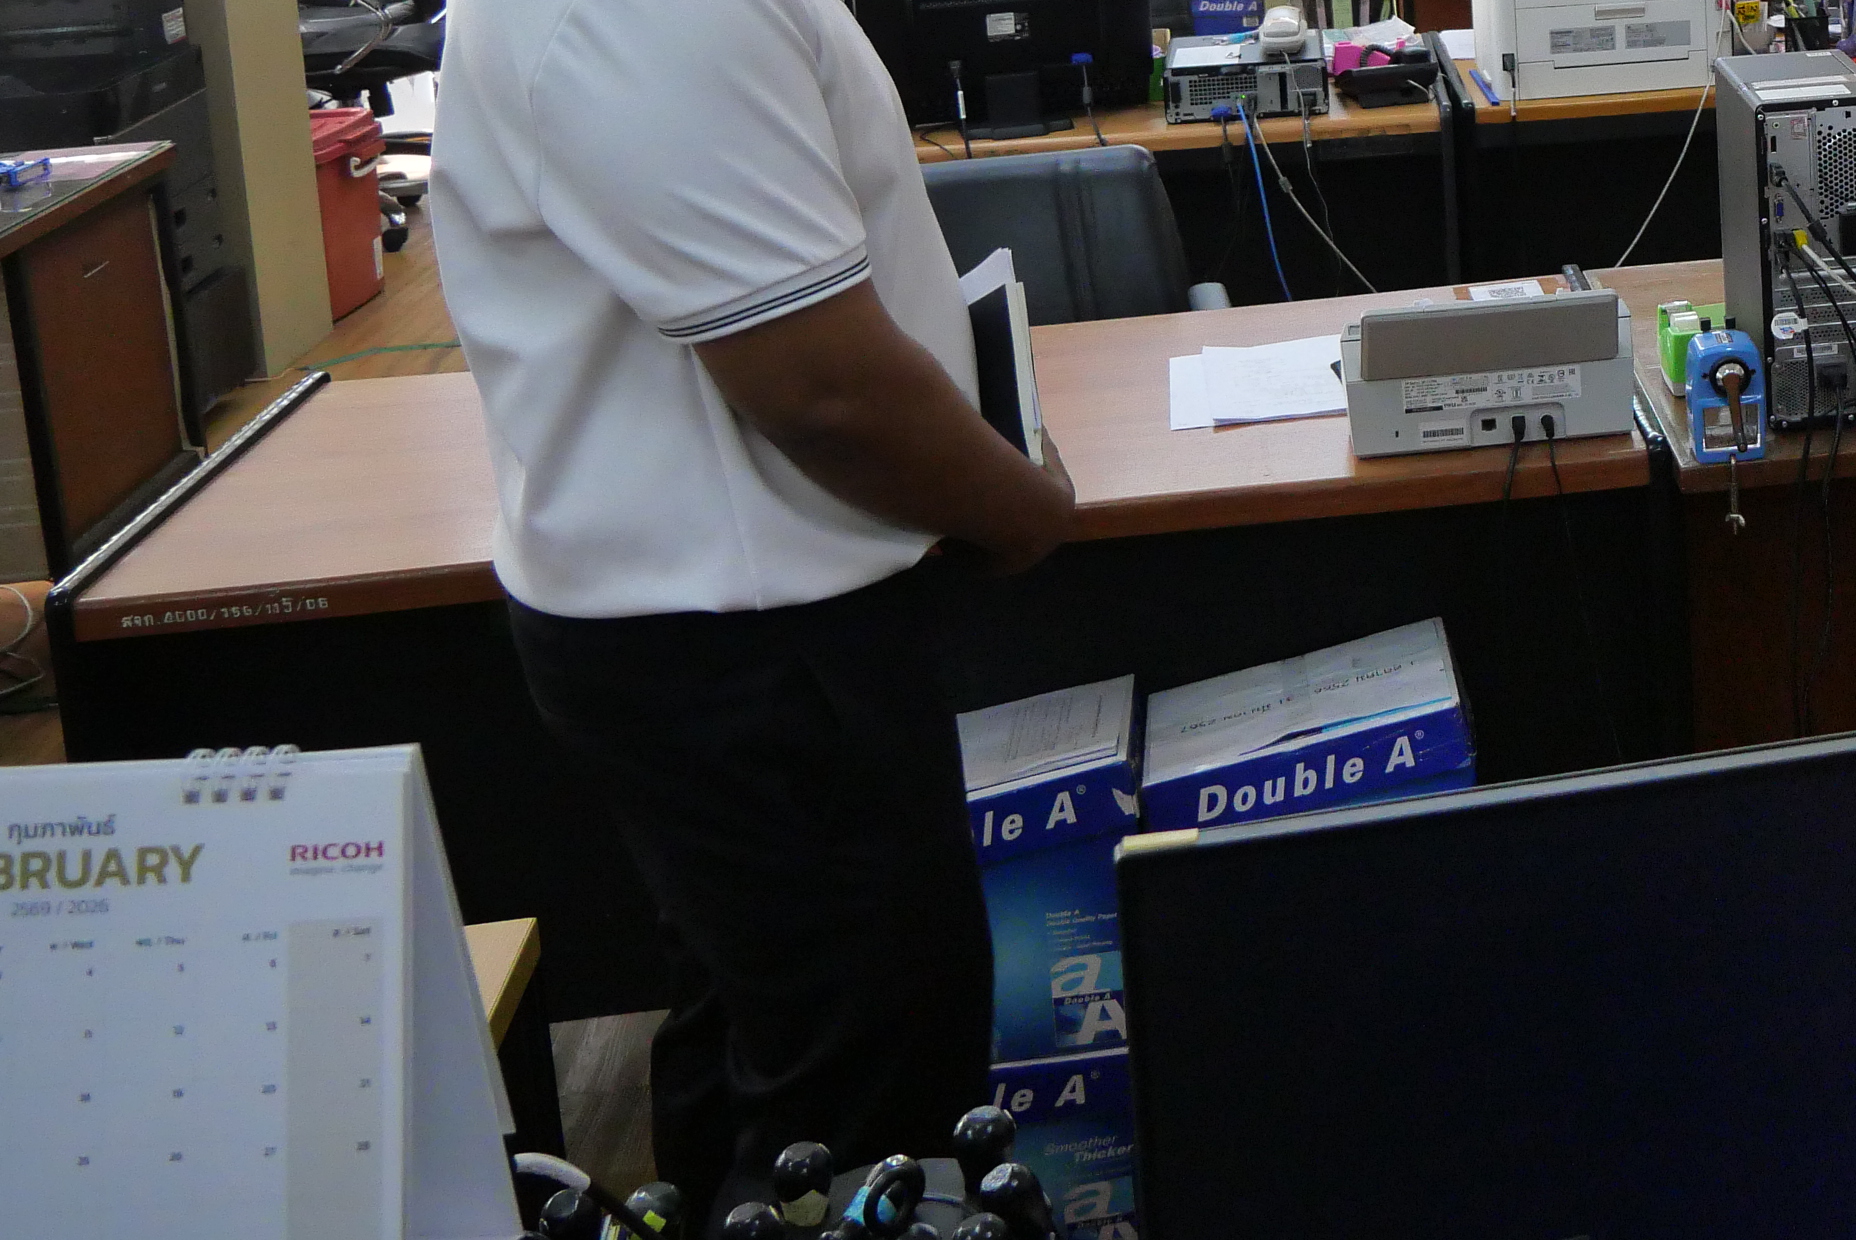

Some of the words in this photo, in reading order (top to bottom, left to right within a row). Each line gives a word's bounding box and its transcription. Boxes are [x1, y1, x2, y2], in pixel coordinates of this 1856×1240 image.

[1199, 0, 1244, 11] Double
[1248, 1, 1258, 11] A
[1197, 754, 1365, 823] Double
[1385, 736, 1416, 774] A
[983, 810, 1024, 847] le
[1046, 790, 1078, 830] A
[290, 840, 385, 862] RICOH
[1054, 1074, 1086, 1107] A
[1044, 1134, 1119, 1156] Smoother
[1073, 1143, 1134, 1162] Thicker
